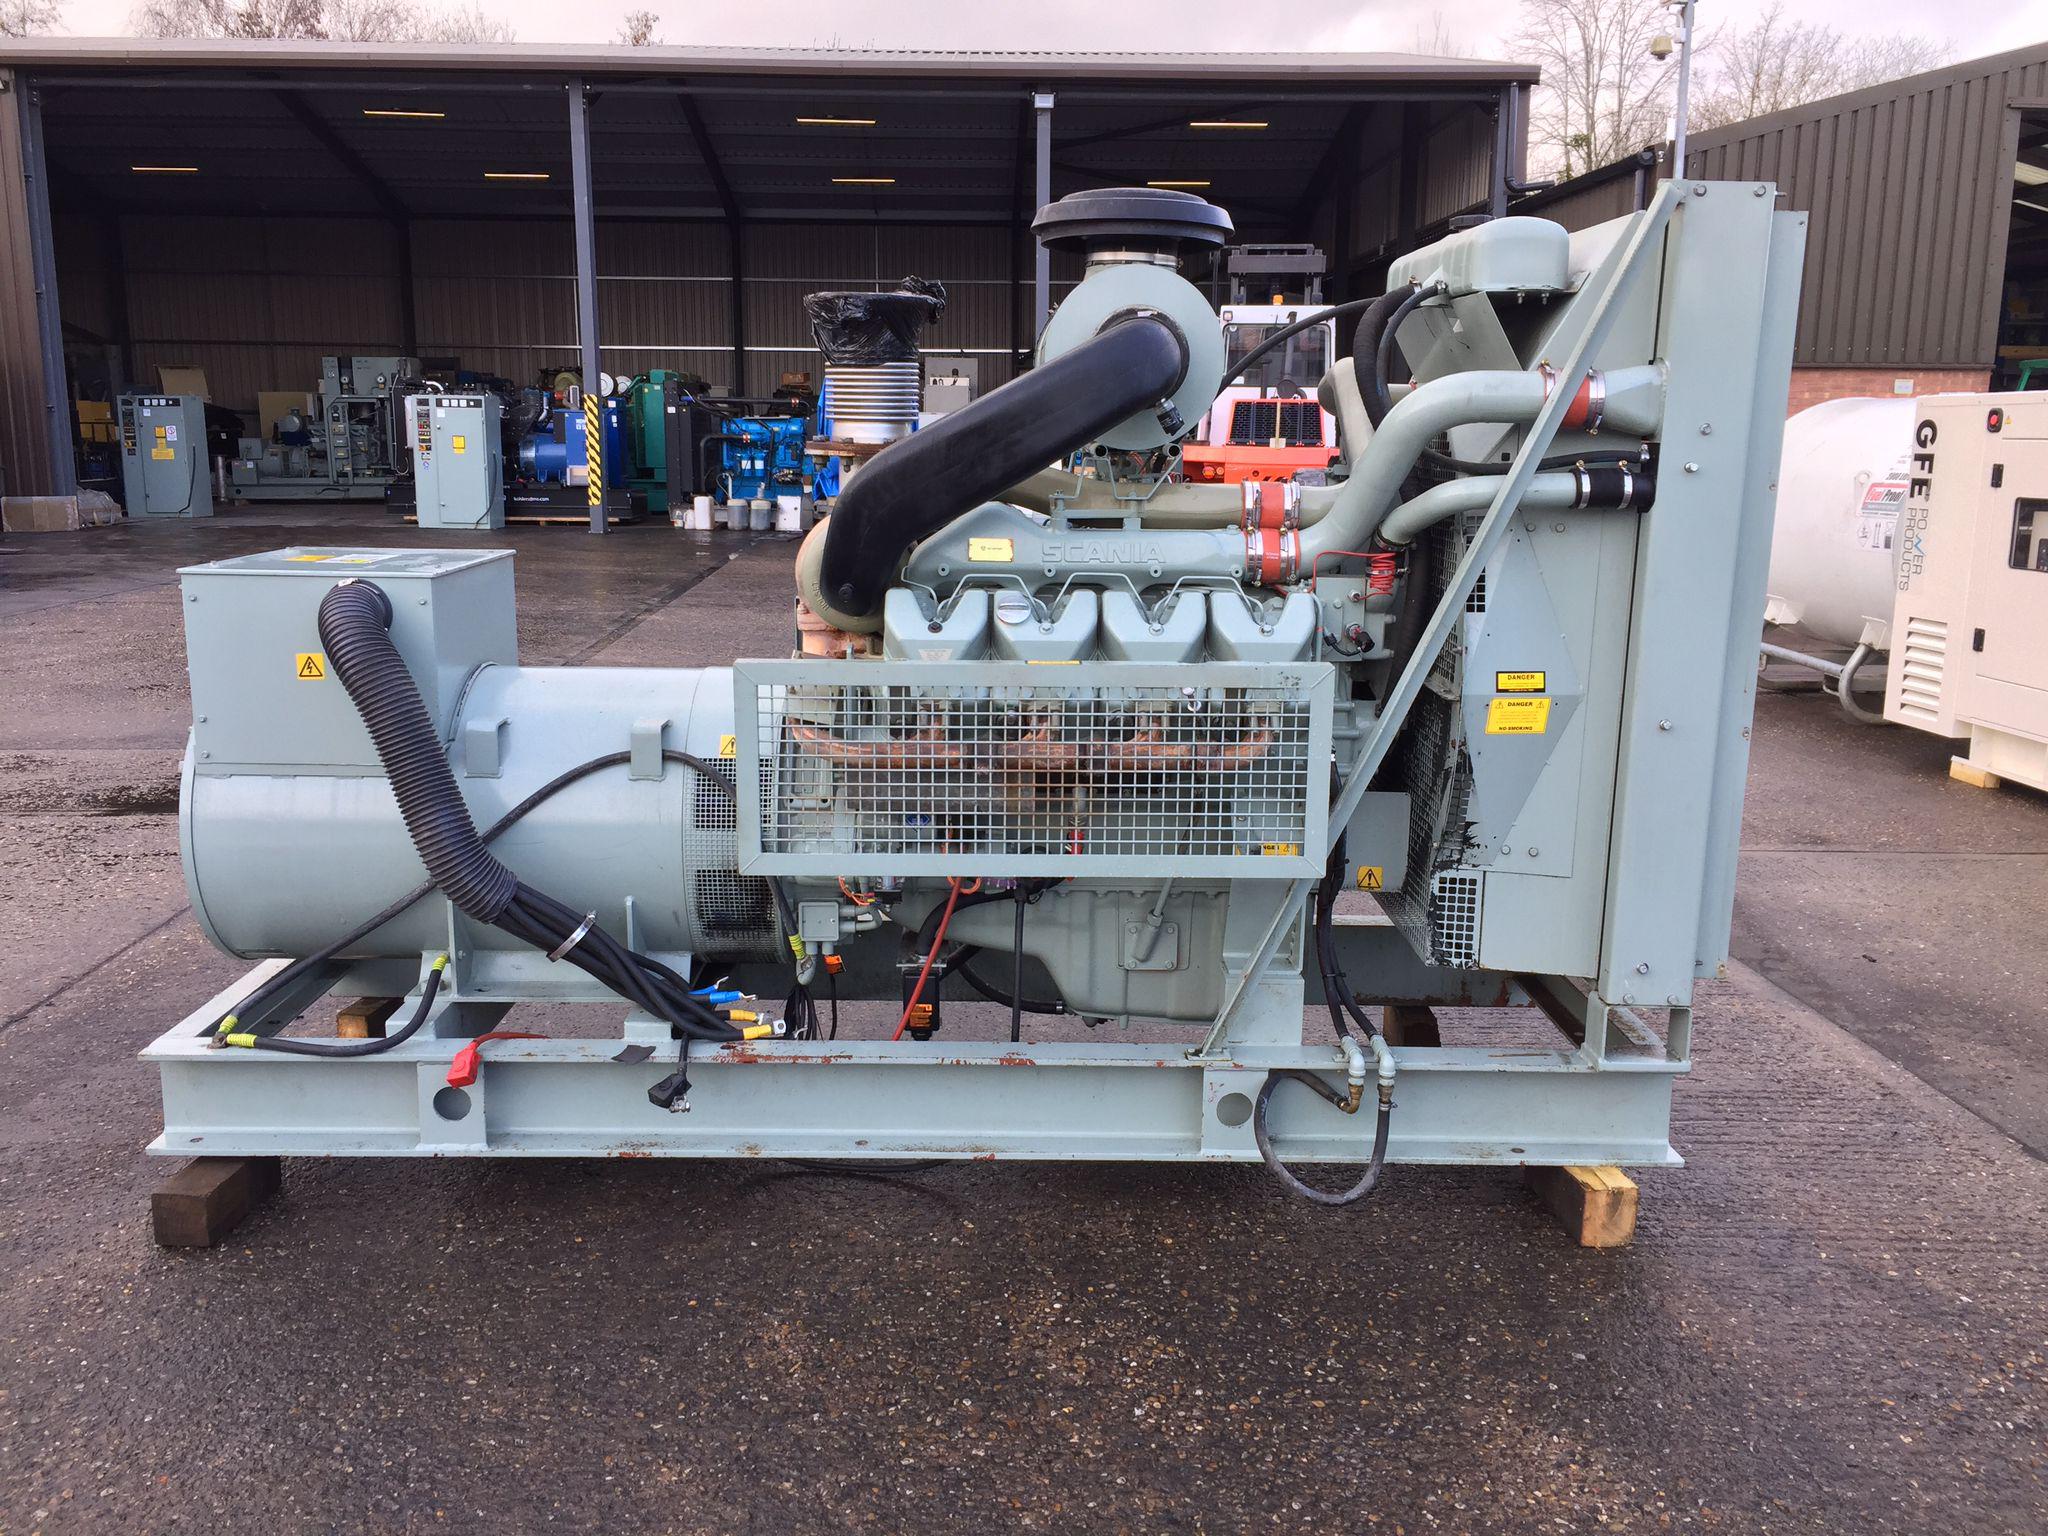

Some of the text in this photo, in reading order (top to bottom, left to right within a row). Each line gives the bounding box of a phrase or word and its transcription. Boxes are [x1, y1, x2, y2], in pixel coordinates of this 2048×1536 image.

[1909, 419, 1938, 498] GFE
[1041, 541, 1167, 563] SCANIA
[1899, 507, 1918, 591] PRODUCTS
